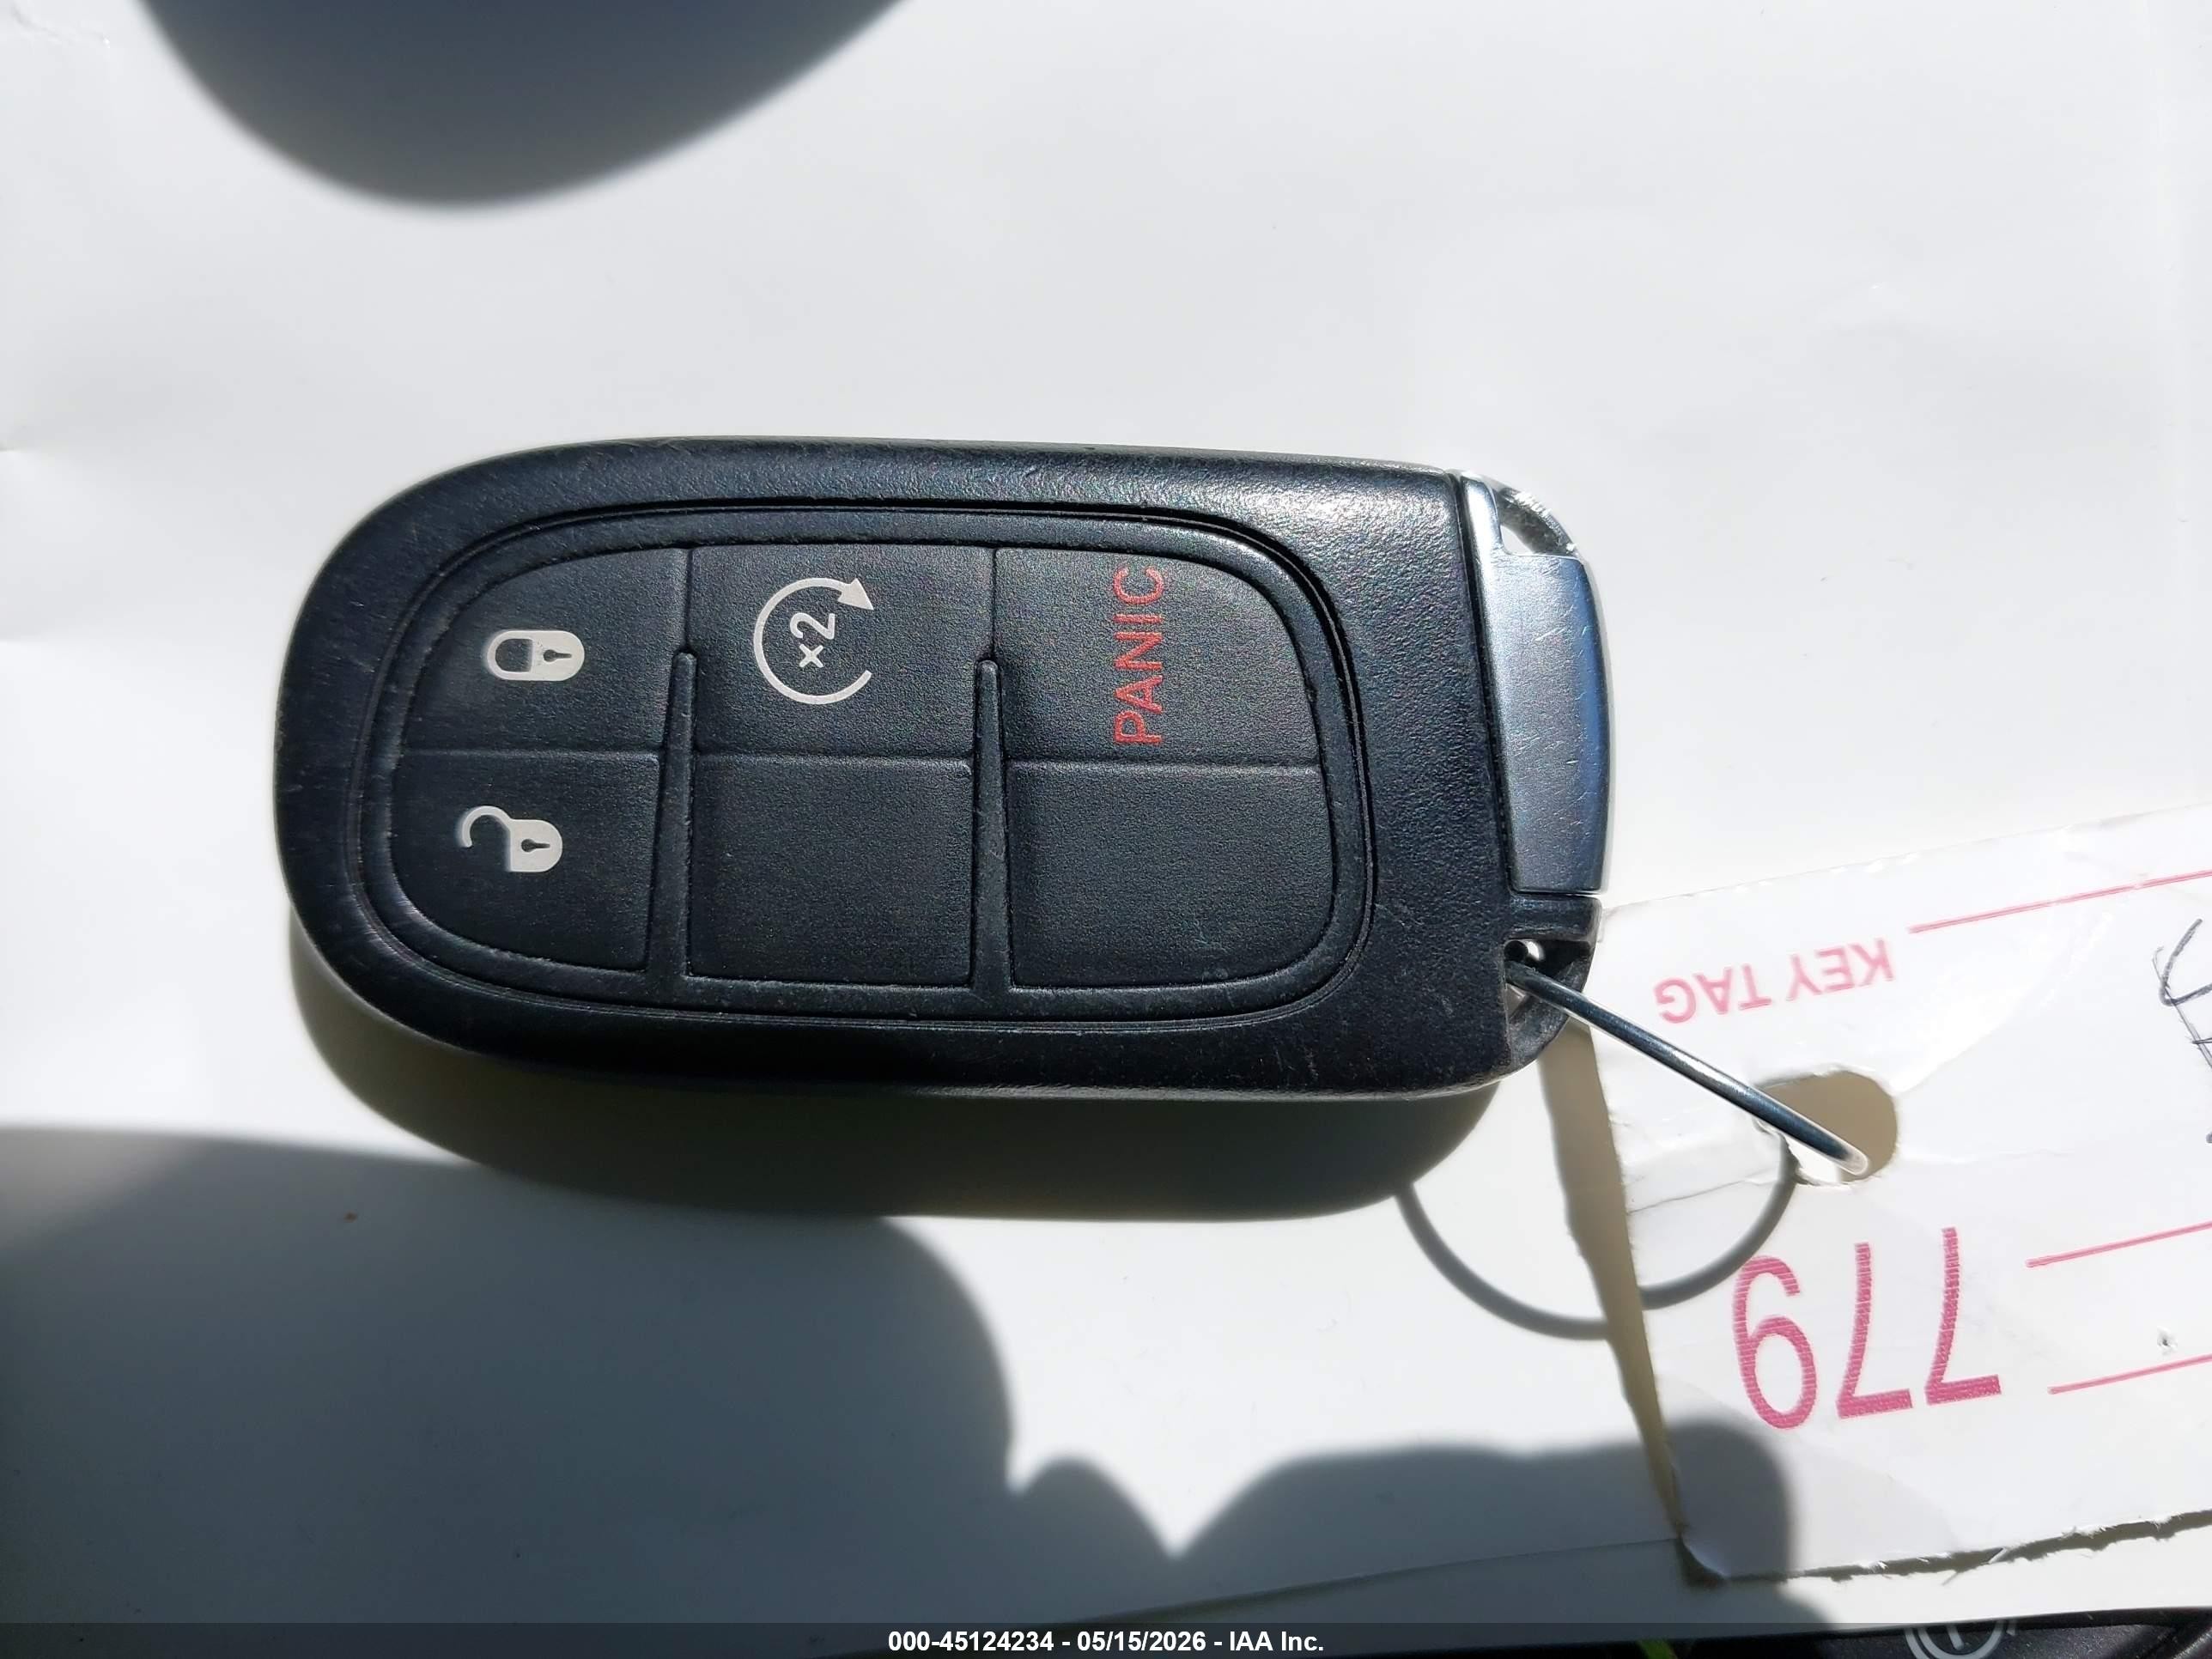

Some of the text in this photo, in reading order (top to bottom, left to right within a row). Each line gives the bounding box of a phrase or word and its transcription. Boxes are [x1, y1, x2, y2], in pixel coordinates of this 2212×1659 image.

[1113, 566, 1165, 746] PANIC
[1653, 939, 1895, 1025] KEY TAG
[1732, 1226, 2003, 1431] 779
